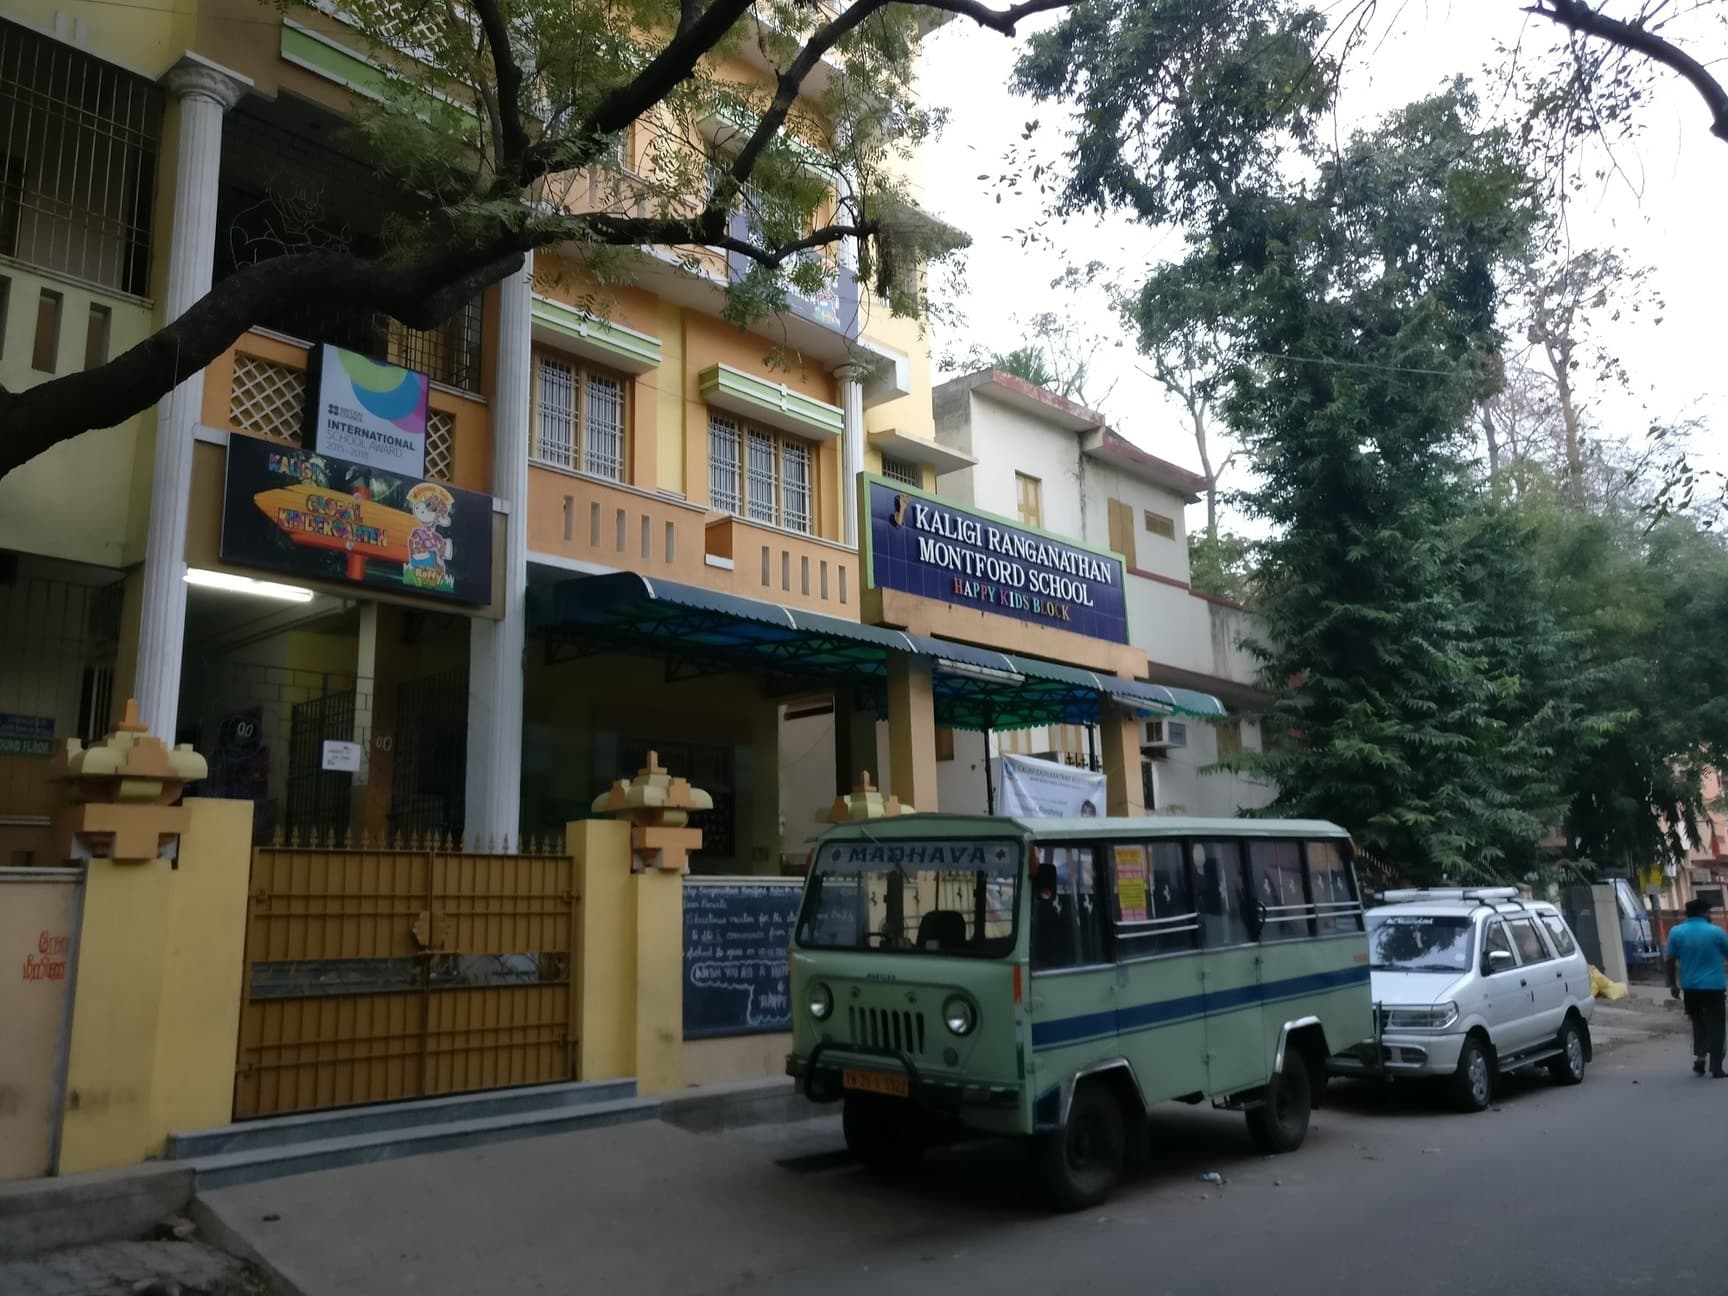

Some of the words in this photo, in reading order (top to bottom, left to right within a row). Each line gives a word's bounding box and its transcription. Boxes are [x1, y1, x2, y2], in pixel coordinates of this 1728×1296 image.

[327, 419, 416, 451] INTERNATIONAL
[327, 429, 365, 449] SCHOOL
[368, 440, 403, 457] AWARD
[278, 508, 388, 546] KINDERGARTEN
[306, 495, 363, 524] GLOBAL
[915, 503, 982, 546] KALIGI
[988, 526, 1112, 584] RANGANATHAN
[919, 536, 1025, 588] MONTFORD
[1029, 568, 1094, 607] SCHOOL
[953, 577, 996, 603] HAPPY
[1000, 590, 1030, 612] KIDS
[1032, 597, 1070, 622] BLOCK
[848, 846, 986, 864] MADHAVA
